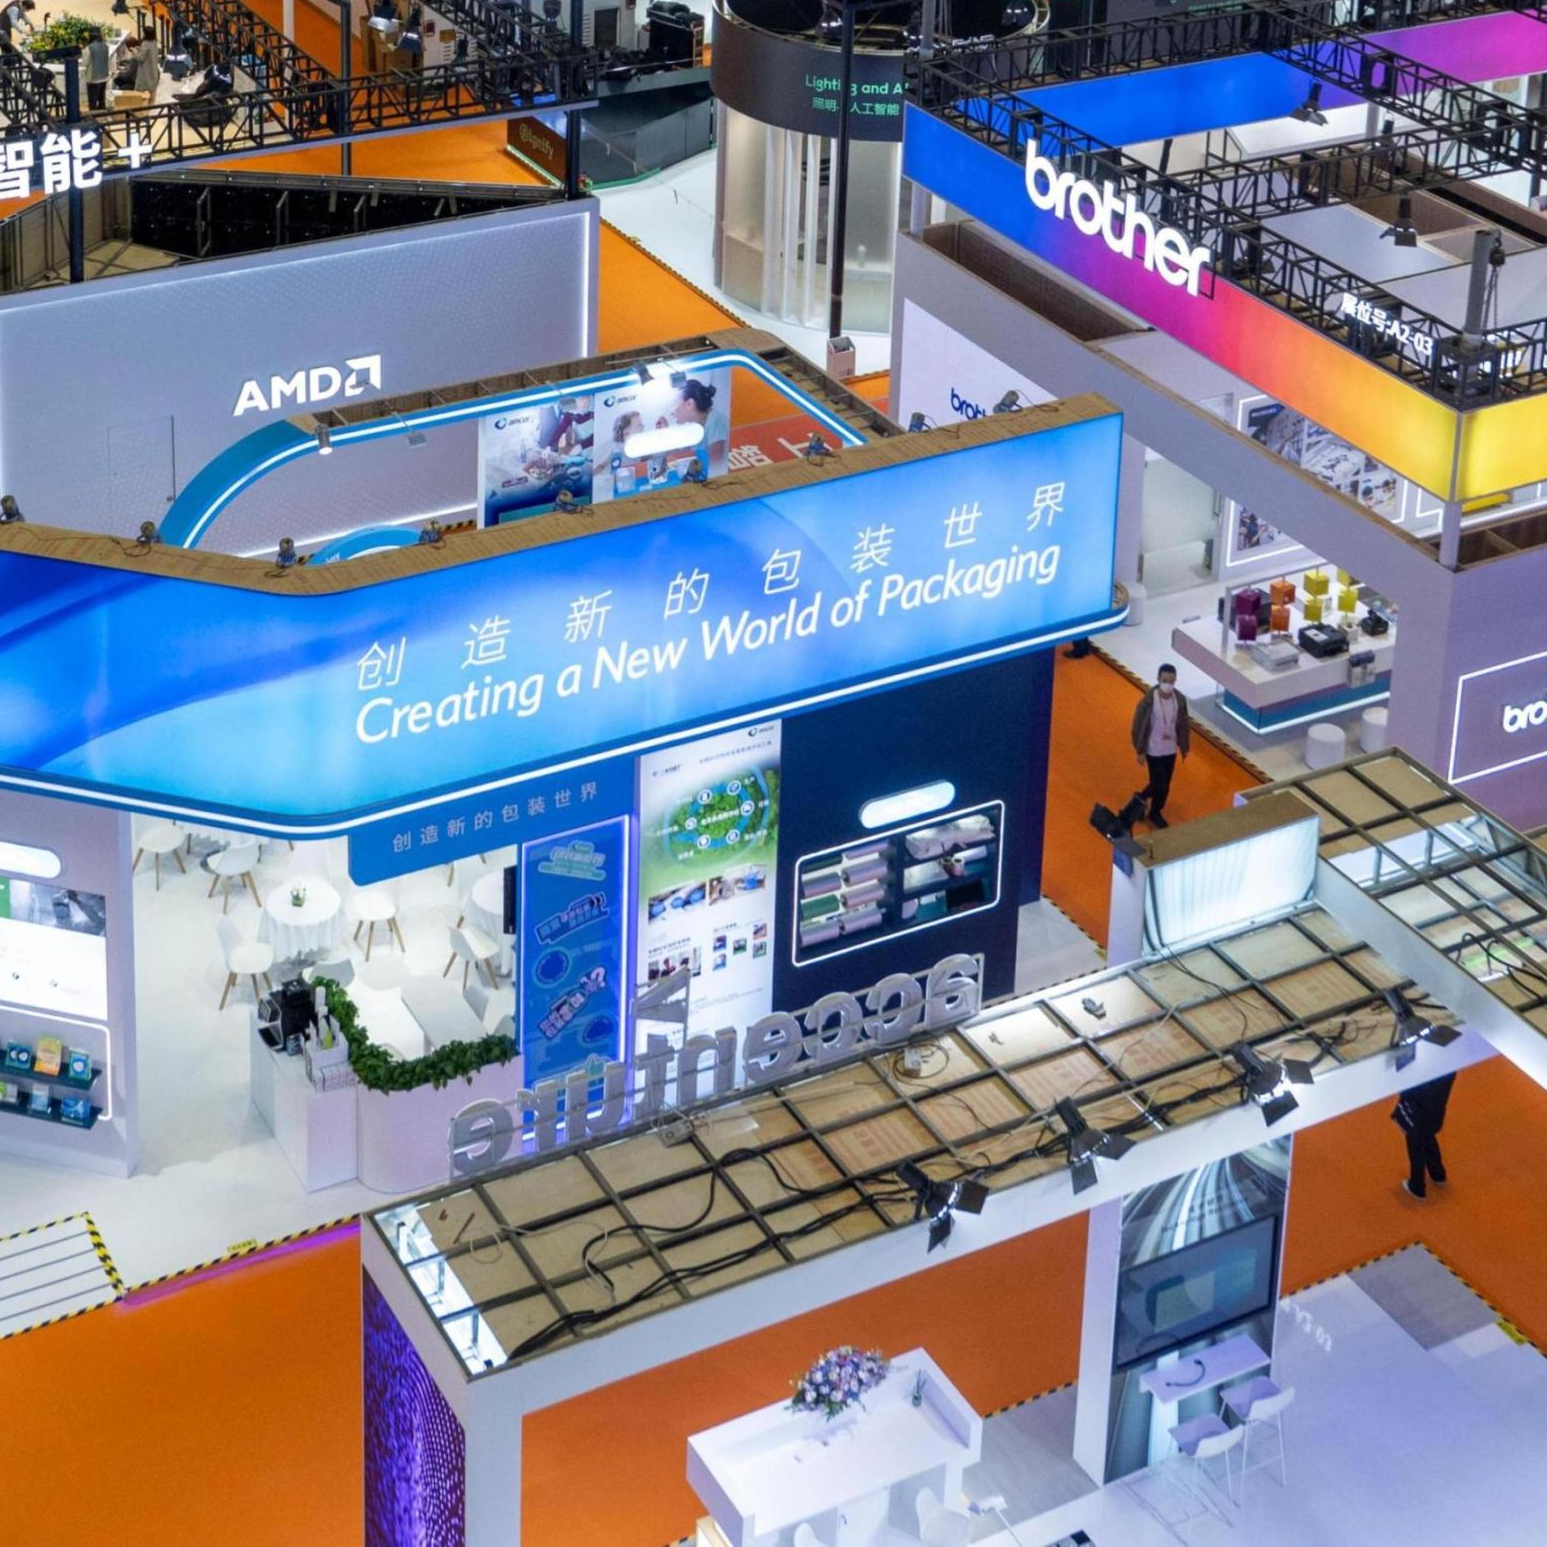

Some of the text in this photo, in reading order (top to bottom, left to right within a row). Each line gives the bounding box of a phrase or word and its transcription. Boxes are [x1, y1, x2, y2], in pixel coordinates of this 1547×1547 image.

[805, 74, 858, 97] Lightig
[862, 82, 889, 94] and
[1023, 138, 1211, 296] brother
[233, 364, 338, 417] AMD
[951, 387, 986, 420] brot
[355, 481, 1067, 690] 创造新的包装世界
[355, 543, 1060, 744] Creating a New World of Packaging
[392, 781, 599, 855] 创造新的包装世界
